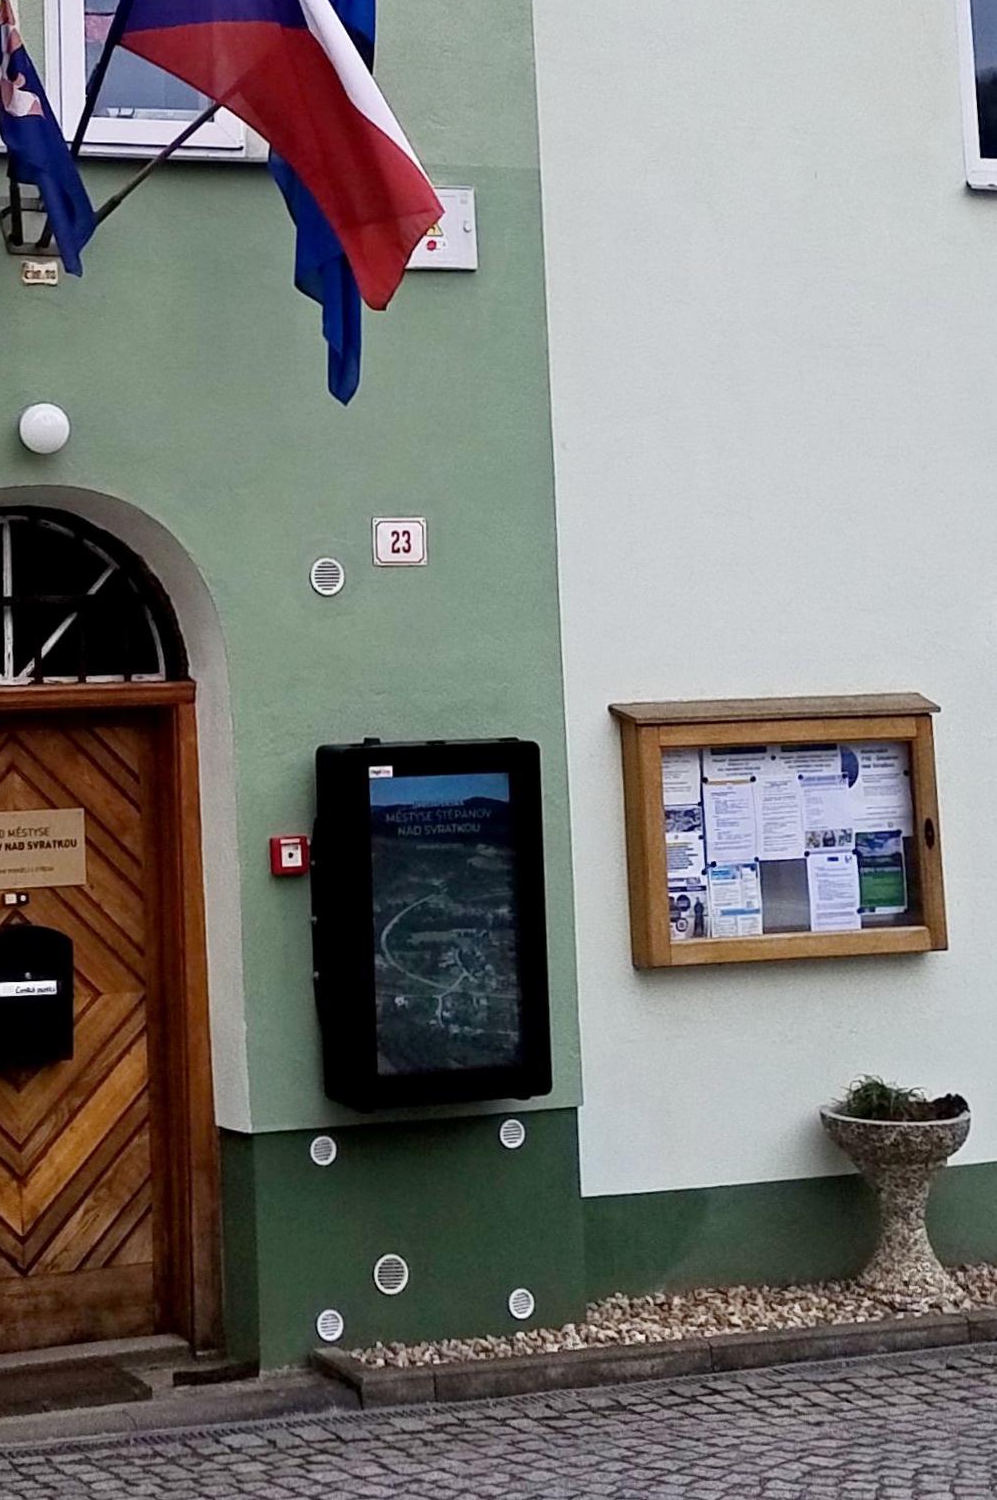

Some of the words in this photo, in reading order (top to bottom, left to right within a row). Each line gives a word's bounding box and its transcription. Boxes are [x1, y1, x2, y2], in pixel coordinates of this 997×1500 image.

[391, 530, 411, 554] 23
[4, 841, 25, 852] NAD
[27, 839, 78, 851] SVRATKOU
